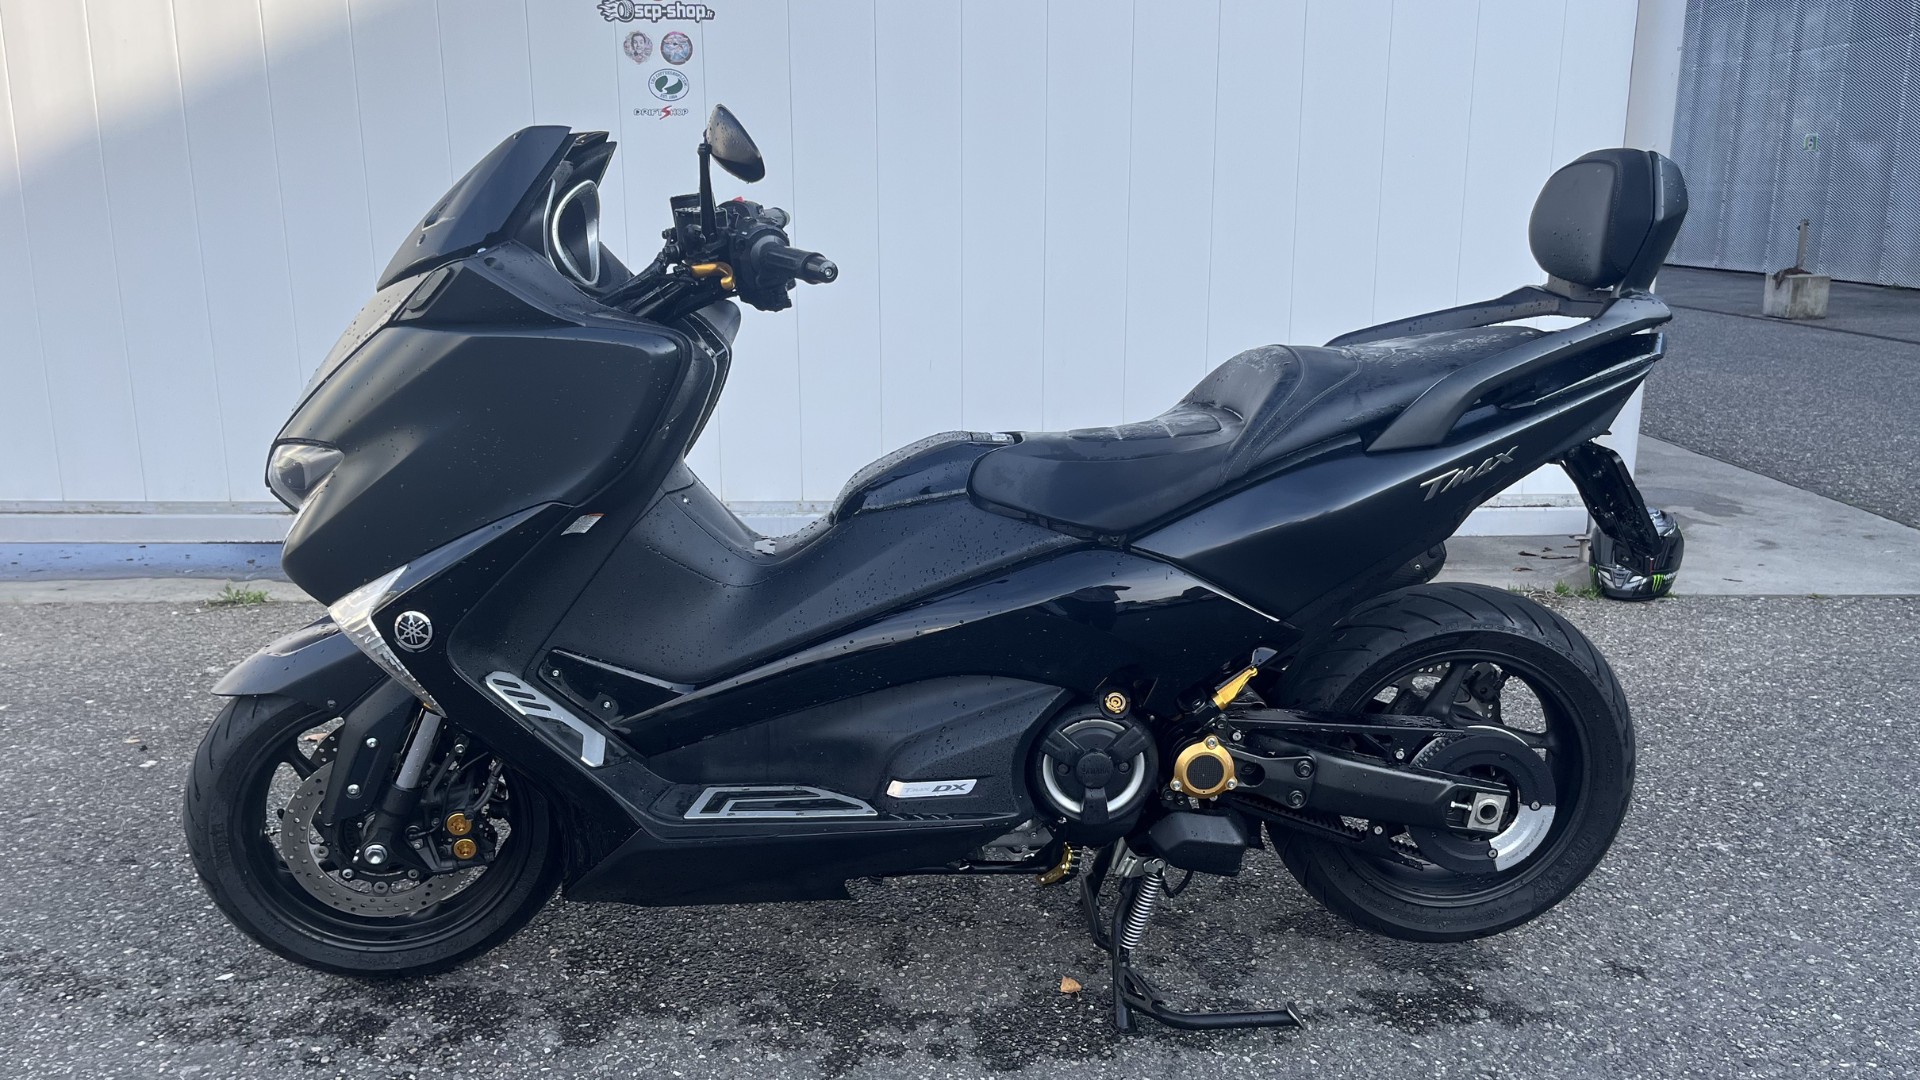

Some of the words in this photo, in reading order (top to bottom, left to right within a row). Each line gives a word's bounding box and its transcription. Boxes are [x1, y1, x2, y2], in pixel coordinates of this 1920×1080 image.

[633, 1, 715, 23] scp-shop.fr
[633, 105, 689, 121] DRIFTSHOP
[1419, 445, 1519, 501] TMAX
[932, 783, 967, 792] DX
